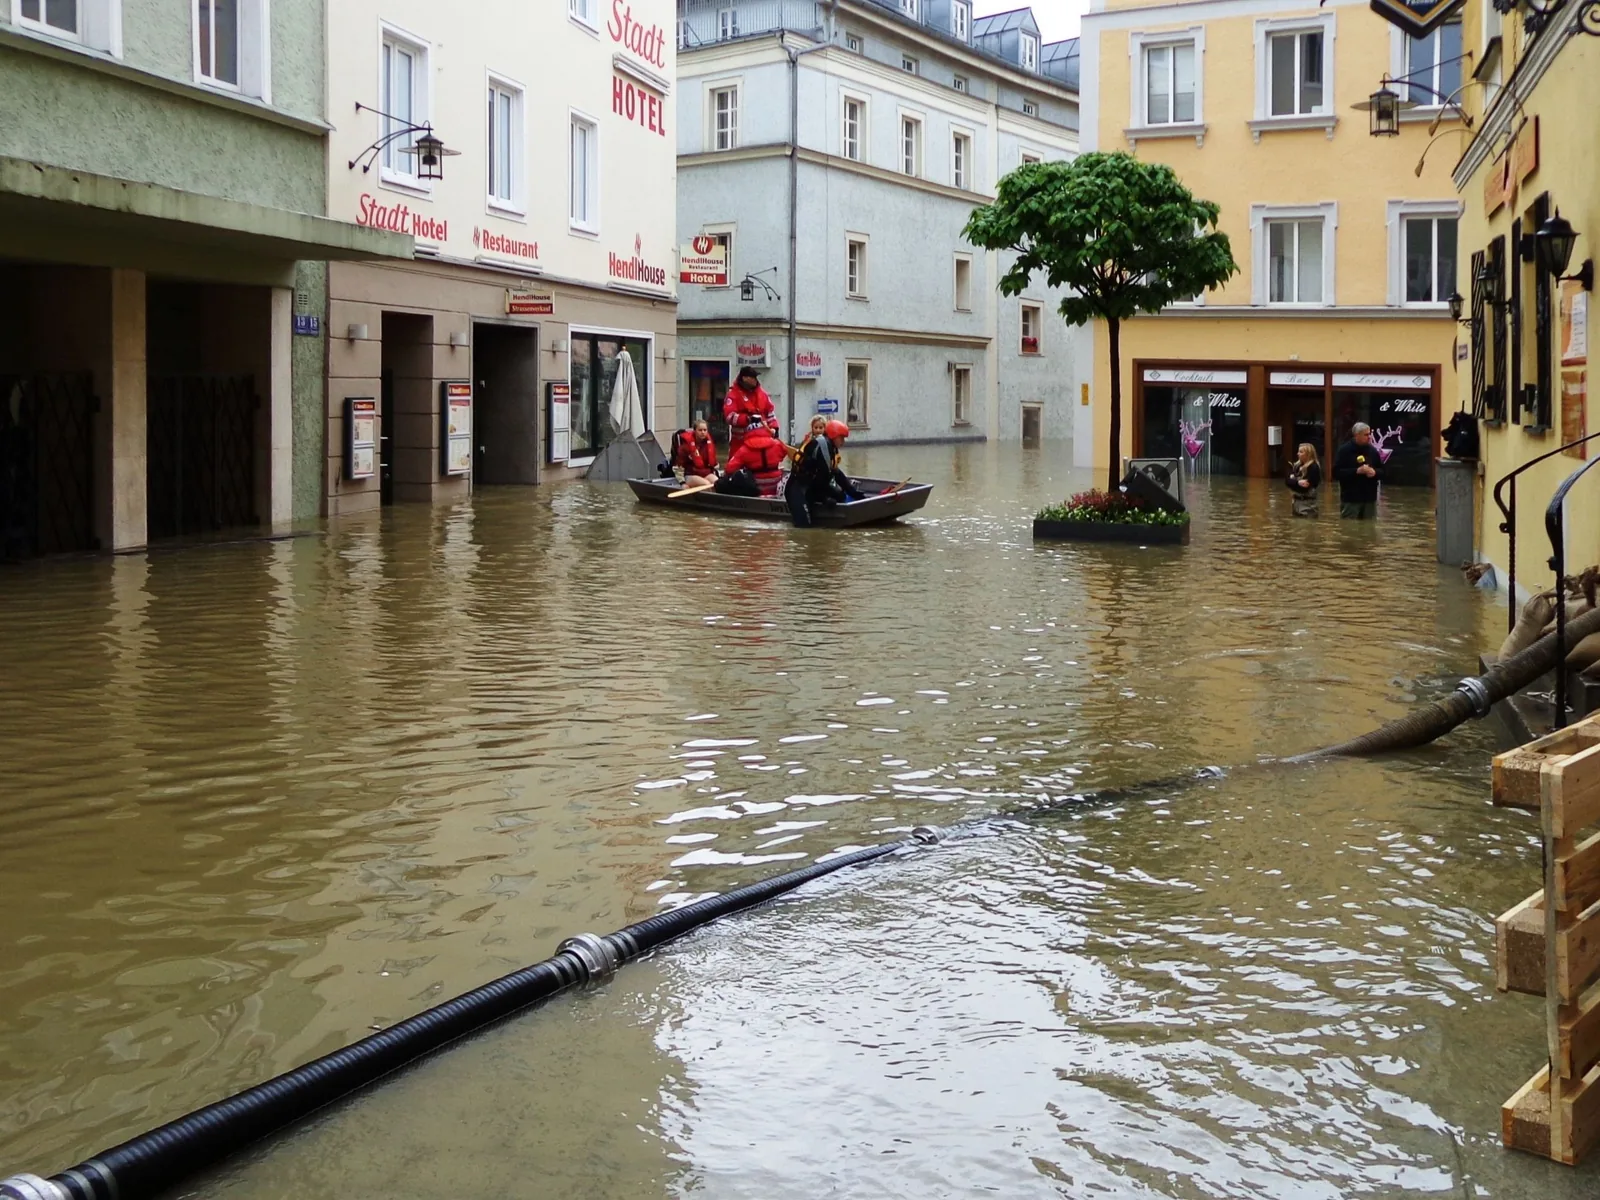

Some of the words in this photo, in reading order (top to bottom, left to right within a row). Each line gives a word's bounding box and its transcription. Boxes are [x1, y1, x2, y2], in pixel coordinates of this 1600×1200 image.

[607, 0, 665, 68] Stadt
[612, 75, 666, 137] HOTEL
[355, 193, 409, 233] Stadt
[412, 212, 447, 242] Hotel
[482, 228, 539, 260] Restaurant
[681, 256, 724, 265] HendlHouse
[608, 251, 666, 286] HendlHouse
[690, 273, 717, 283] Hotel
[310, 317, 318, 328] 15
[1173, 371, 1214, 382] Cocktails
[1284, 374, 1310, 384] Bar
[1354, 375, 1399, 386] Lounge
[1193, 396, 1204, 407] &
[1207, 392, 1242, 408] White
[1379, 401, 1390, 412] &
[1394, 398, 1428, 413] White
